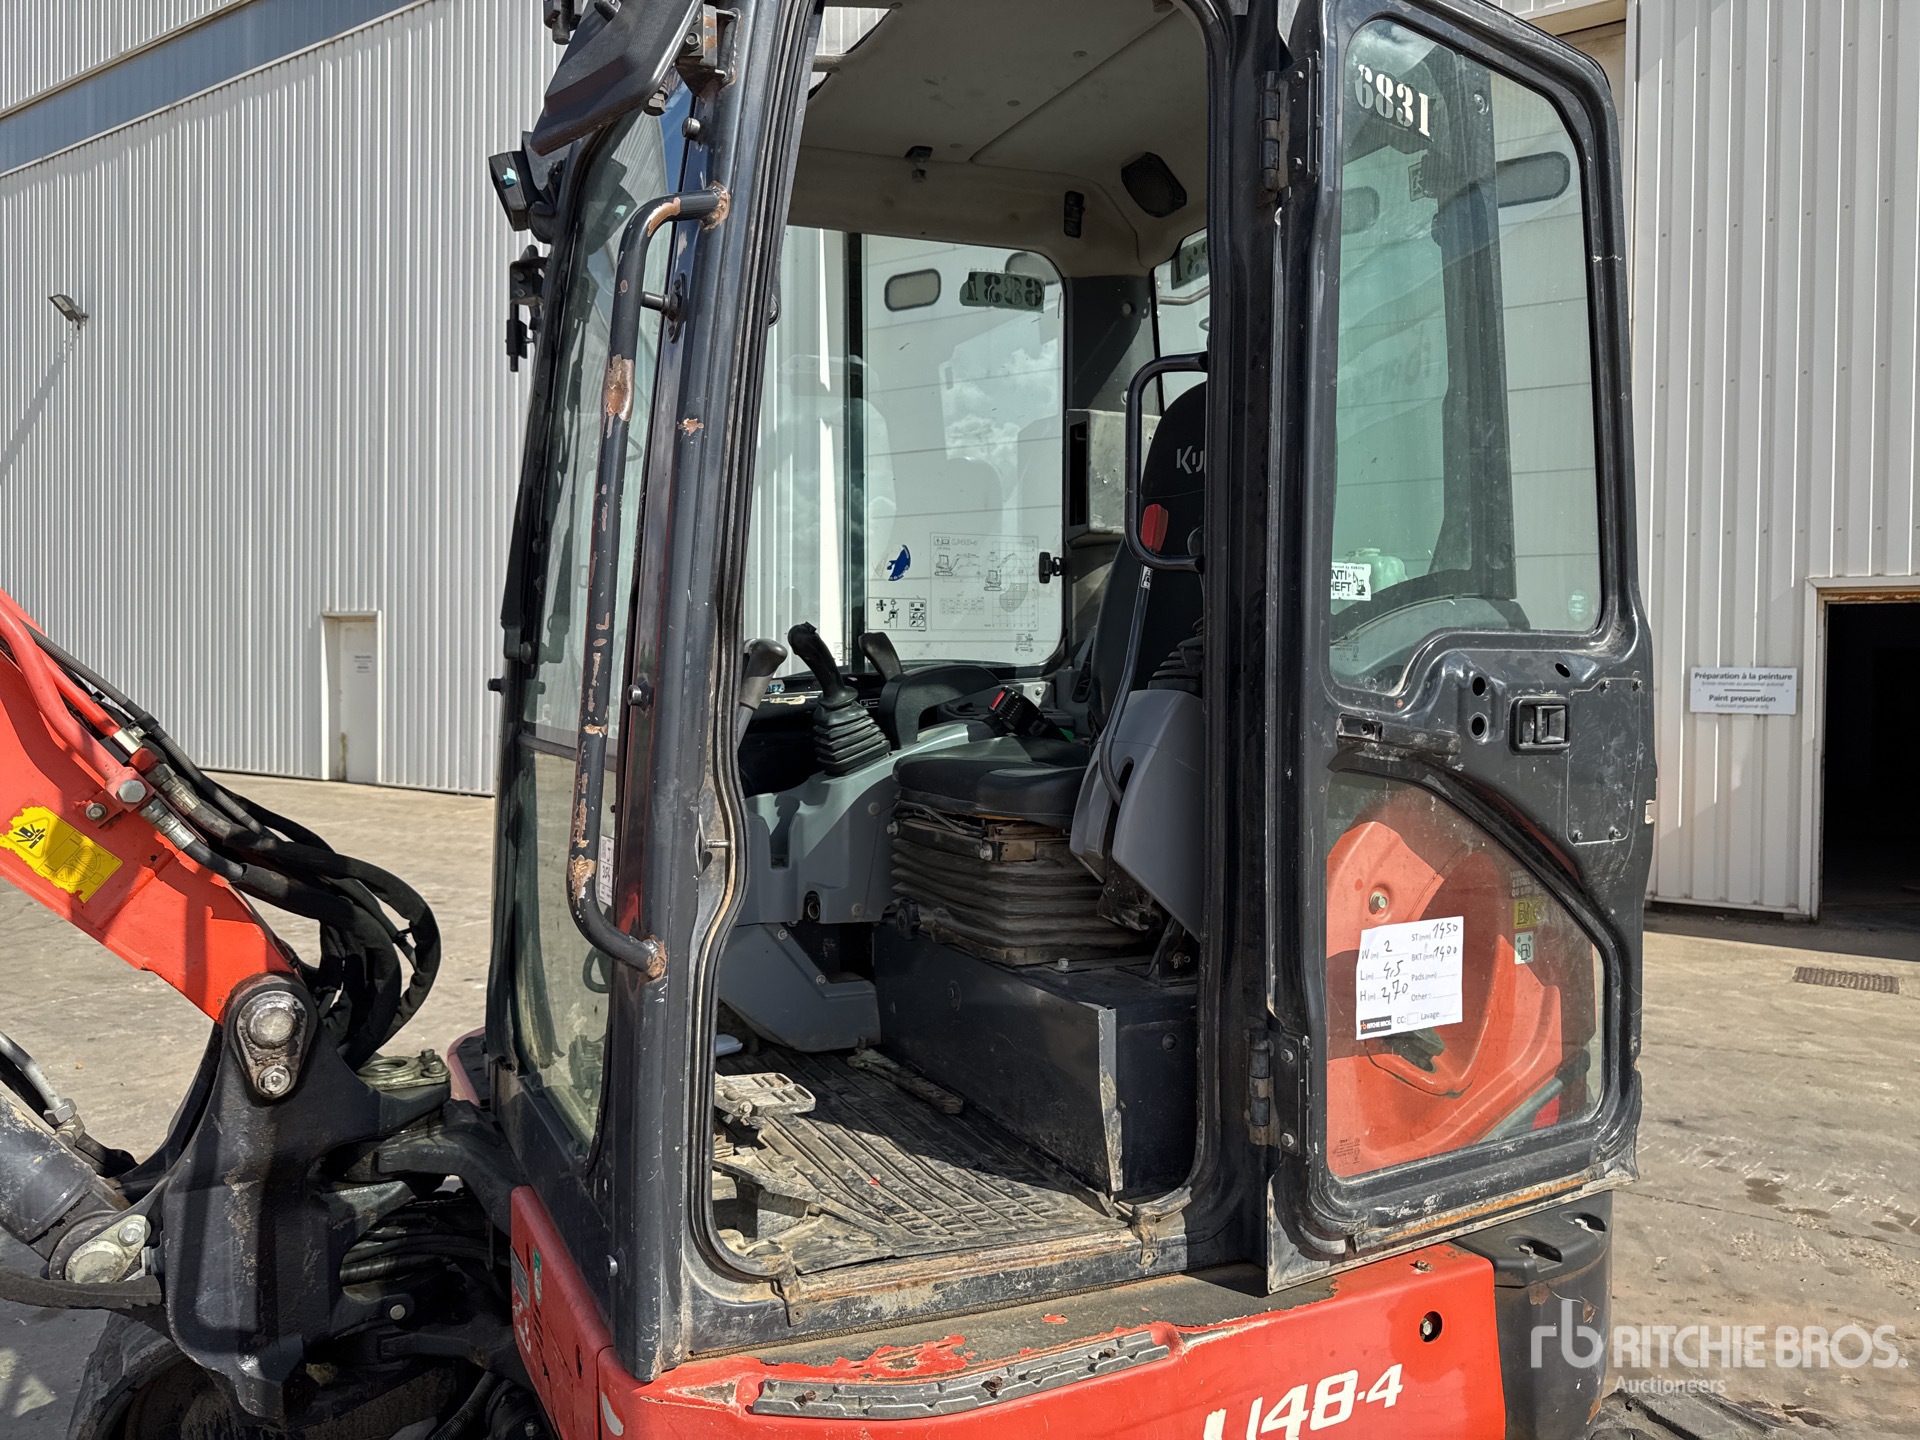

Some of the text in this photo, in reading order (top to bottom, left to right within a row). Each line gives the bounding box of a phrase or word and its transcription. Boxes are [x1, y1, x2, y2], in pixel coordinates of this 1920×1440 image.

[1355, 64, 1430, 137] 6831
[1332, 569, 1347, 580] NTI
[1694, 671, 1740, 681] Préparation
[1748, 672, 1757, 680] la
[1758, 673, 1793, 681] peinture
[1709, 694, 1776, 703] Paint preparation
[1432, 922, 1459, 940] 1450
[1383, 939, 1393, 953] 2
[1433, 945, 1458, 962] 1400
[1420, 1010, 1440, 1021] Lavage
